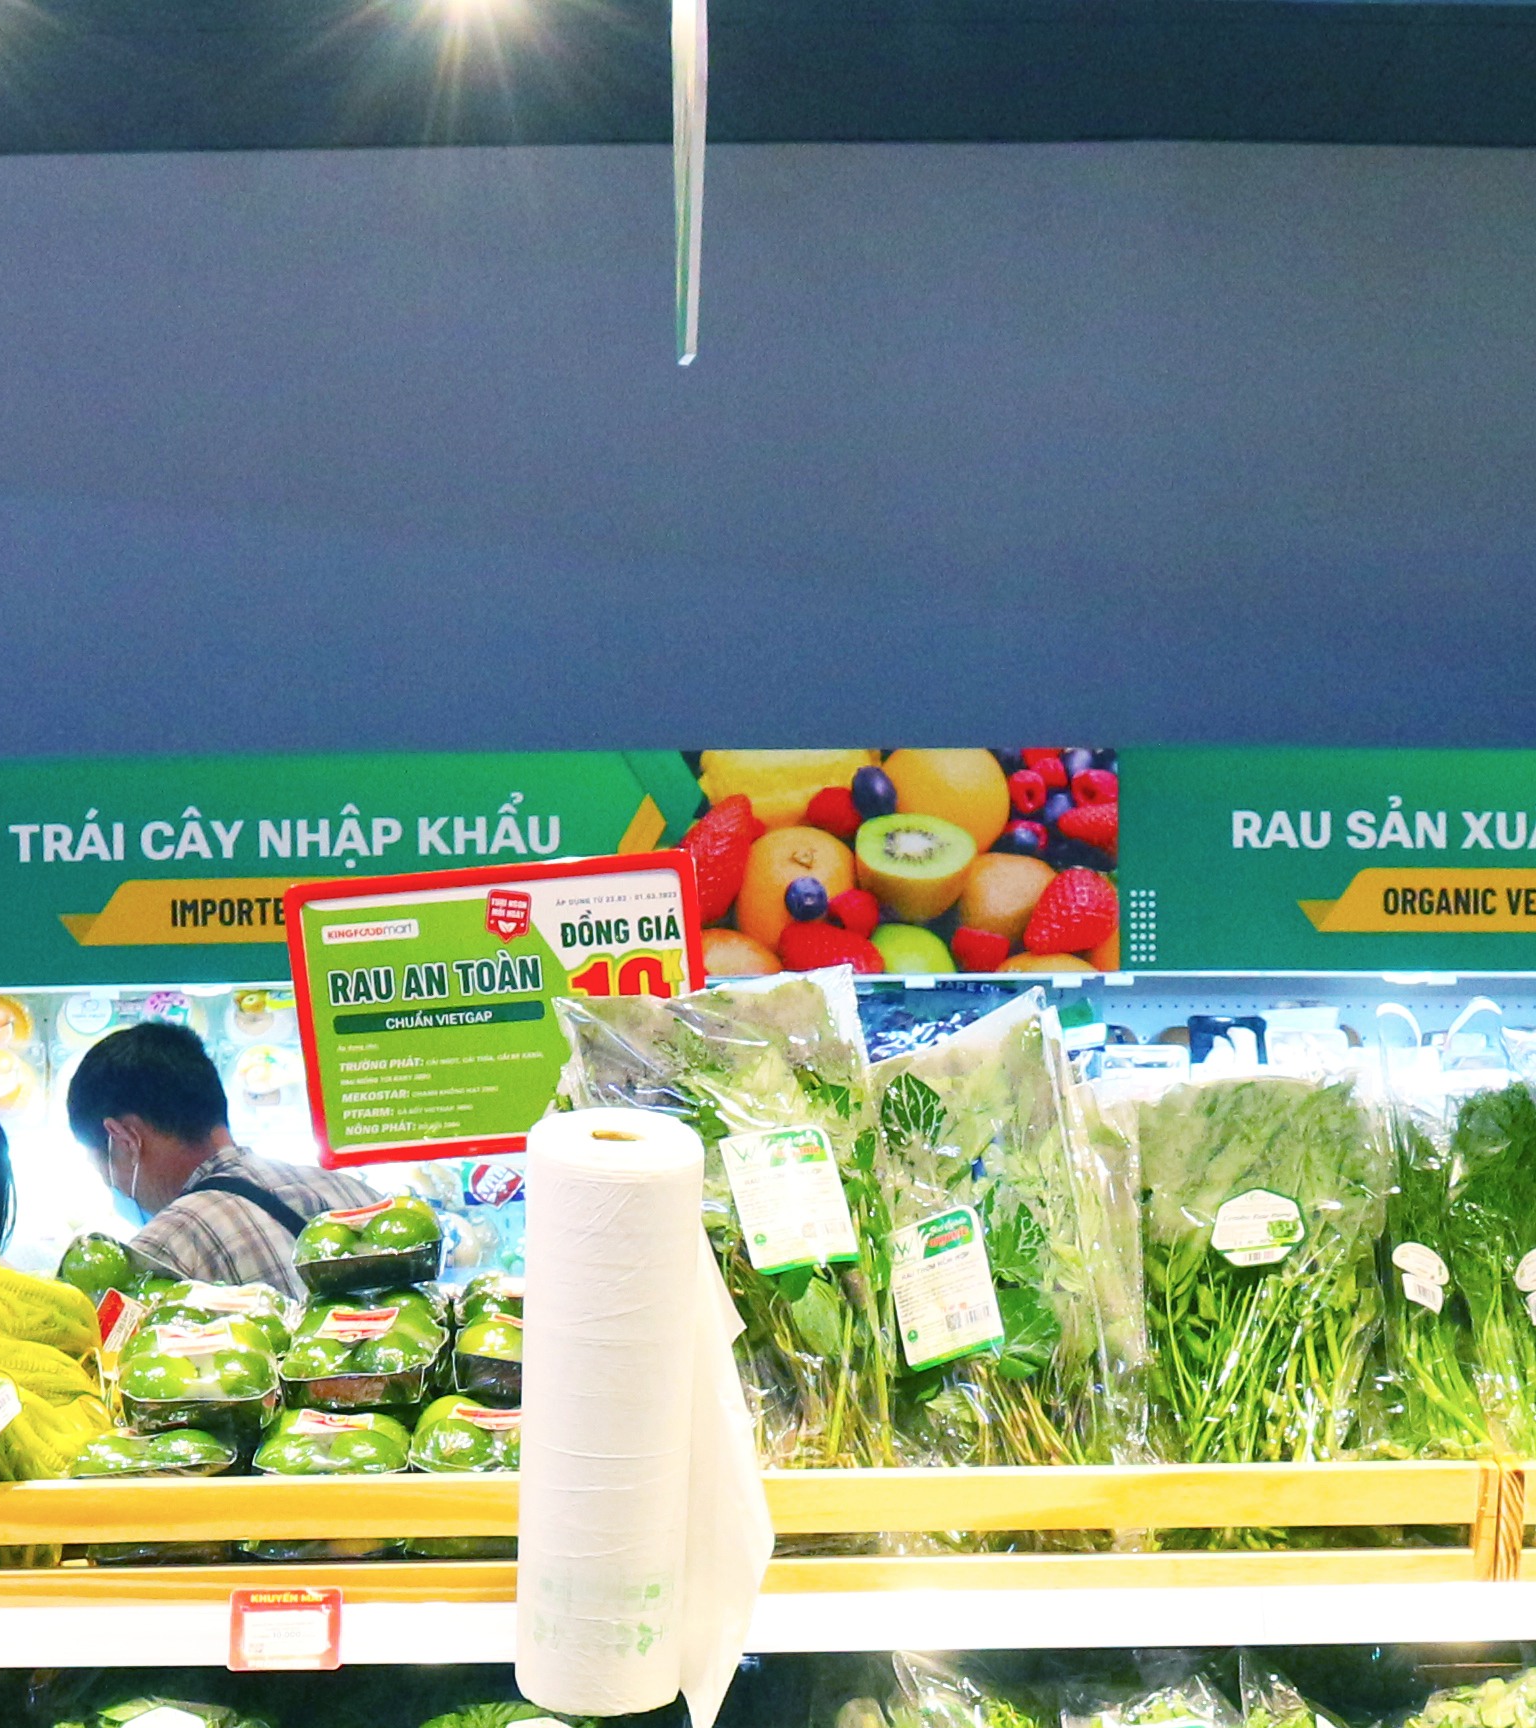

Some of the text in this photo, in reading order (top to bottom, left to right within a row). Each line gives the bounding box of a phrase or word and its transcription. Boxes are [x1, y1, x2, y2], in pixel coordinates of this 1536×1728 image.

[9, 791, 561, 869] TRÁI CÂY NHẬP KHẨU
[1231, 809, 1332, 849] RAU
[1346, 796, 1447, 850] SẢN
[171, 897, 286, 928] IMPORTE
[1383, 886, 1497, 917] ORGANIC
[561, 908, 681, 948] ĐỒNG GIÁ
[328, 949, 543, 1007] RAU AN TOÀN
[385, 1009, 493, 1031] CHUẨN VIETGAP
[341, 1089, 410, 1104] MEKOSTAR:
[343, 1107, 394, 1120] PTFARM:
[250, 1593, 298, 1604] KHUYẾN
